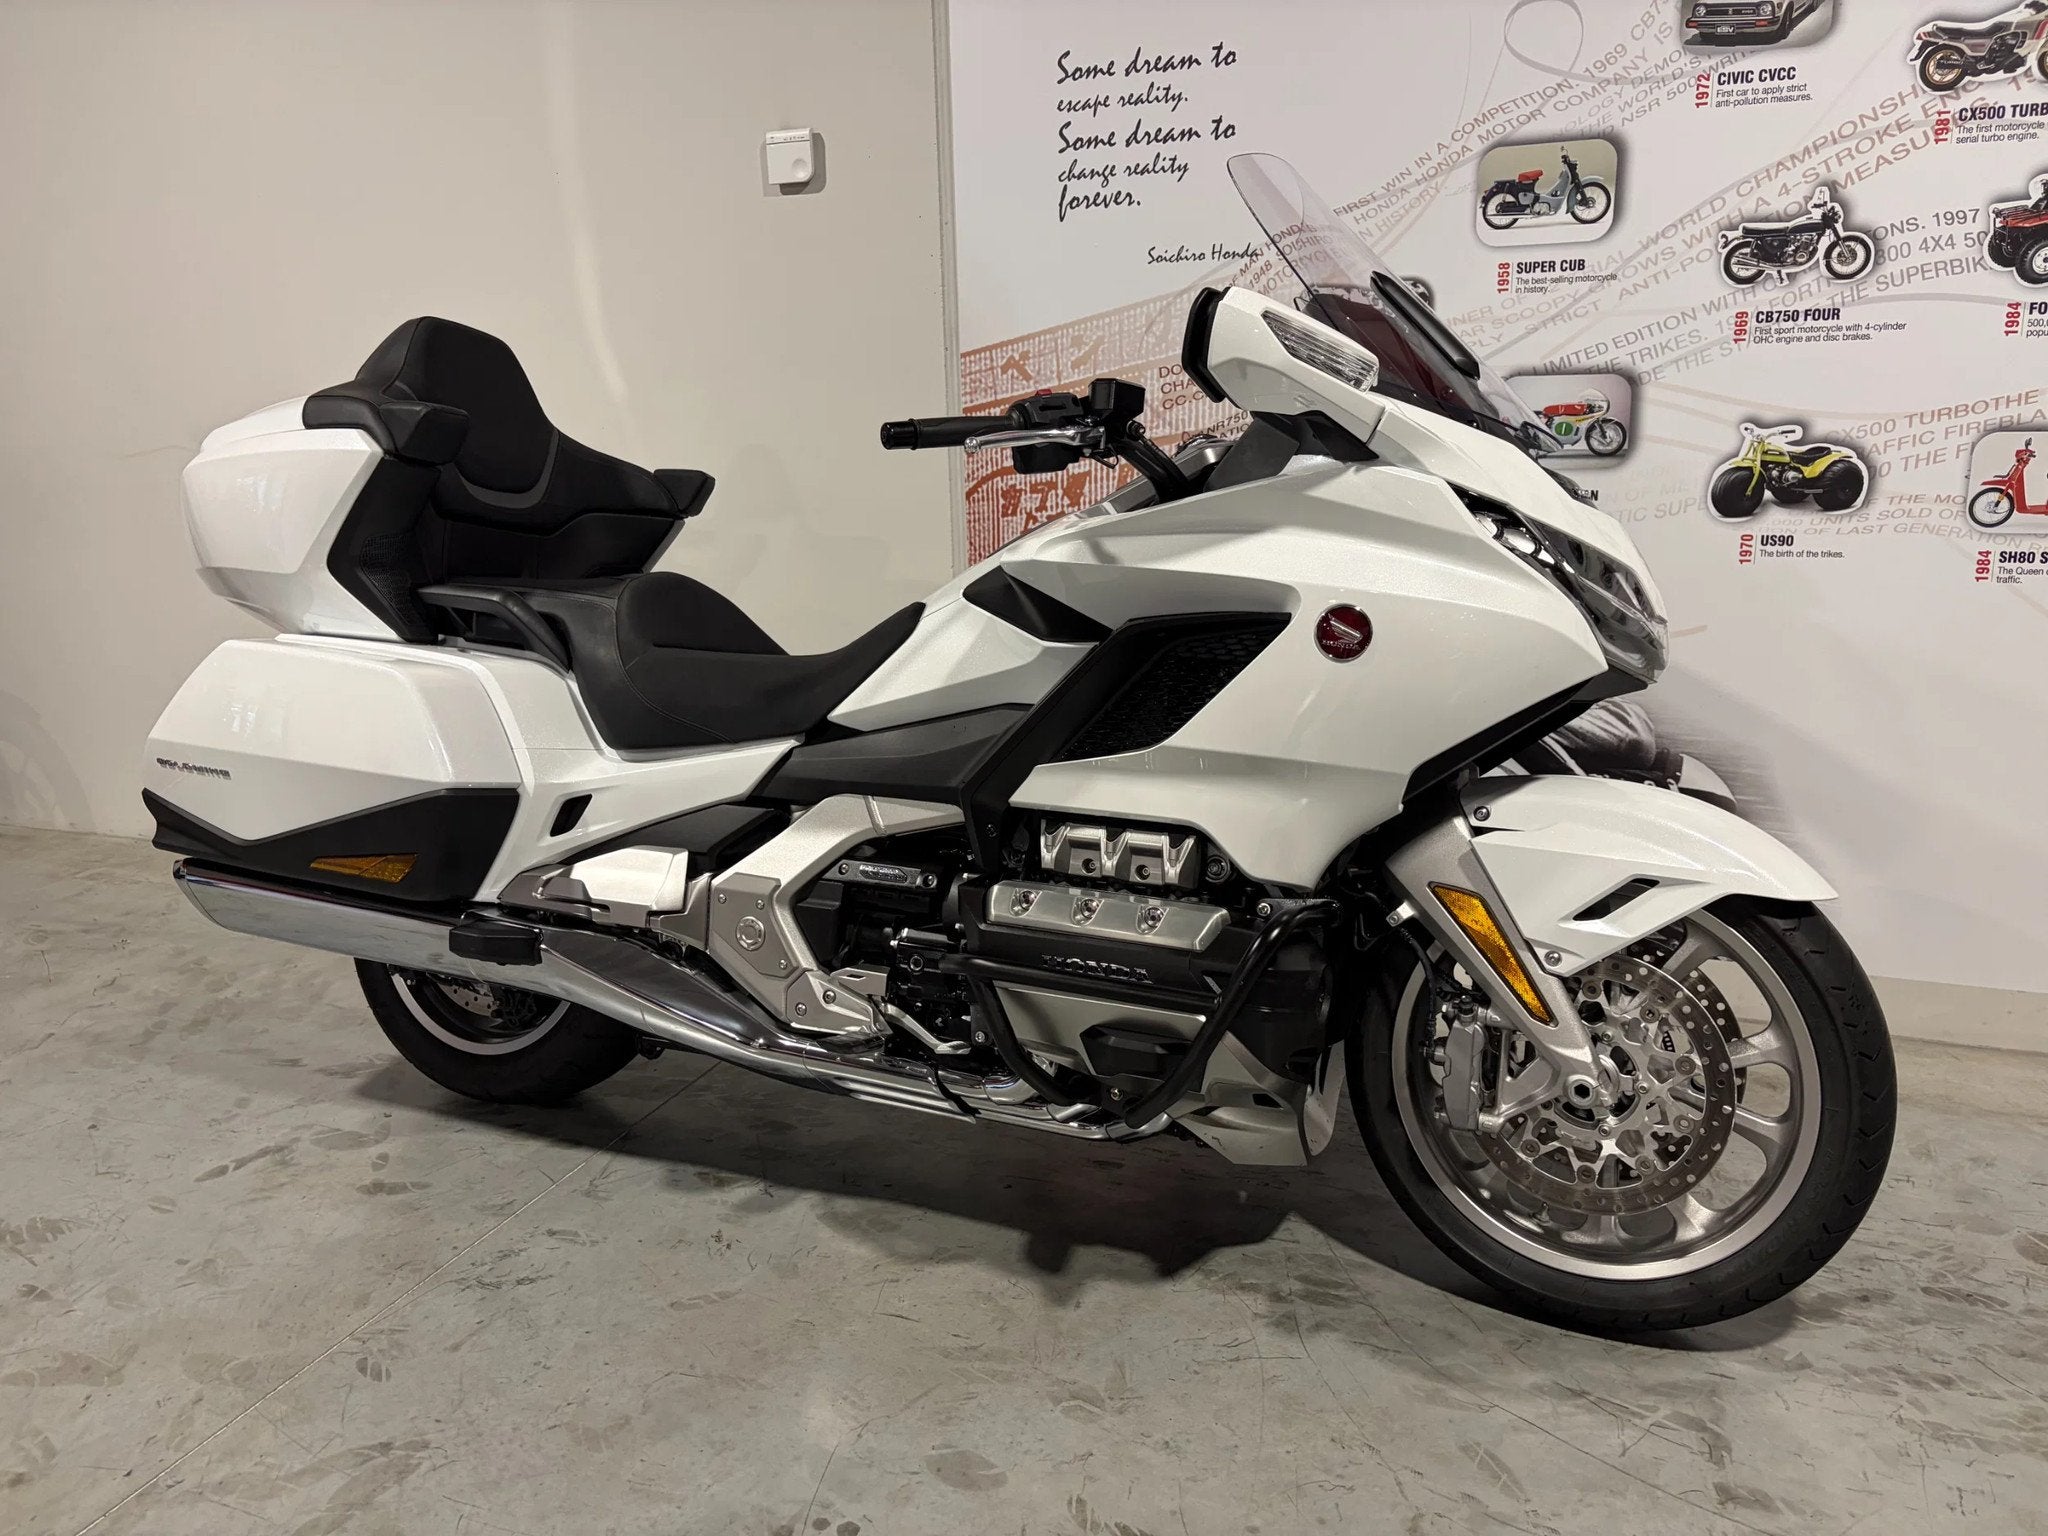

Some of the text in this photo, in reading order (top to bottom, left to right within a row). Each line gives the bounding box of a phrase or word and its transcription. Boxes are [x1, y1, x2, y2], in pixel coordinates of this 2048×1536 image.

[1057, 41, 1237, 85] Some dream to
[1618, 55, 1702, 113] WORLD'S
[1717, 66, 1796, 86] CIVIC CVCC
[1057, 81, 1188, 118] escape reality.
[1621, 97, 1661, 127] NSR
[1667, 76, 1697, 101] 500
[1695, 72, 1711, 108] 1972
[1715, 93, 1813, 108] anti-pollution measures.
[1716, 83, 1807, 98] First car to apply strict
[1958, 105, 2006, 121] CX500
[1058, 114, 1237, 154] Some dream to
[1333, 191, 1377, 217] FIRST
[1381, 167, 1412, 193] WIN
[1414, 152, 1432, 169] IN
[1436, 142, 1449, 155] A
[1451, 78, 1580, 142] COMPETITION.
[1583, 43, 1627, 78] 1969
[1933, 110, 1951, 145] 1981
[1957, 120, 2045, 134] The first motorcycle
[1981, 133, 2005, 143] turbo
[2007, 131, 2039, 143] engine.
[1248, 260, 1273, 289] 1948
[1353, 187, 1411, 225] HONDA
[1415, 144, 1473, 186] HONDA
[1477, 108, 1546, 145] MOTOR
[1553, 47, 1648, 112] COMPANY
[1654, 21, 1673, 45] IS
[1638, 197, 1727, 250] WORLD
[1736, 82, 1927, 198] CHAMPIONSH
[1058, 152, 1189, 188] change reality
[1682, 211, 1745, 250] WITH
[1754, 196, 1771, 213] A
[1777, 113, 1915, 197] 4-STROKE
[1058, 184, 1141, 222] forever.
[1932, 208, 1980, 228] 1997
[1147, 242, 1259, 265] Soichiro Honda
[1516, 258, 1586, 274] SUPER CUB
[1876, 255, 1991, 292] SUPERBIK
[1497, 262, 1511, 294] 1958
[1515, 273, 1618, 286] The best-selling motorcycle
[1515, 285, 1550, 295] in history.
[1626, 328, 1708, 368] TRIKES.
[1919, 233, 1957, 254] 4X4
[1612, 310, 1698, 348] EDITION
[1701, 285, 1757, 315] WITH
[1733, 311, 1749, 344] 1969
[1755, 308, 1841, 324] CB750 FOUR
[2004, 302, 2021, 336] 1984
[1753, 335, 1774, 344] OHC
[1775, 336, 1804, 345] engine
[1822, 333, 1841, 342] disc
[1842, 332, 1873, 342] brakes.
[1754, 322, 1907, 336] First sport motorcycle with 4-cylinder
[1900, 449, 1946, 472] THE
[1887, 494, 1926, 506] THE
[1877, 508, 1931, 521] SOLD
[1760, 534, 1794, 547] US90
[1836, 524, 1888, 536] LAST
[1738, 534, 1754, 565] 1970
[1760, 549, 1845, 559] The birth of the trikes.
[1999, 551, 2036, 564] SH80
[1975, 550, 1992, 582] 1984
[1998, 566, 2044, 576] The Queen
[1996, 576, 2023, 584] traffic.
[1041, 954, 1153, 985] HONDA
